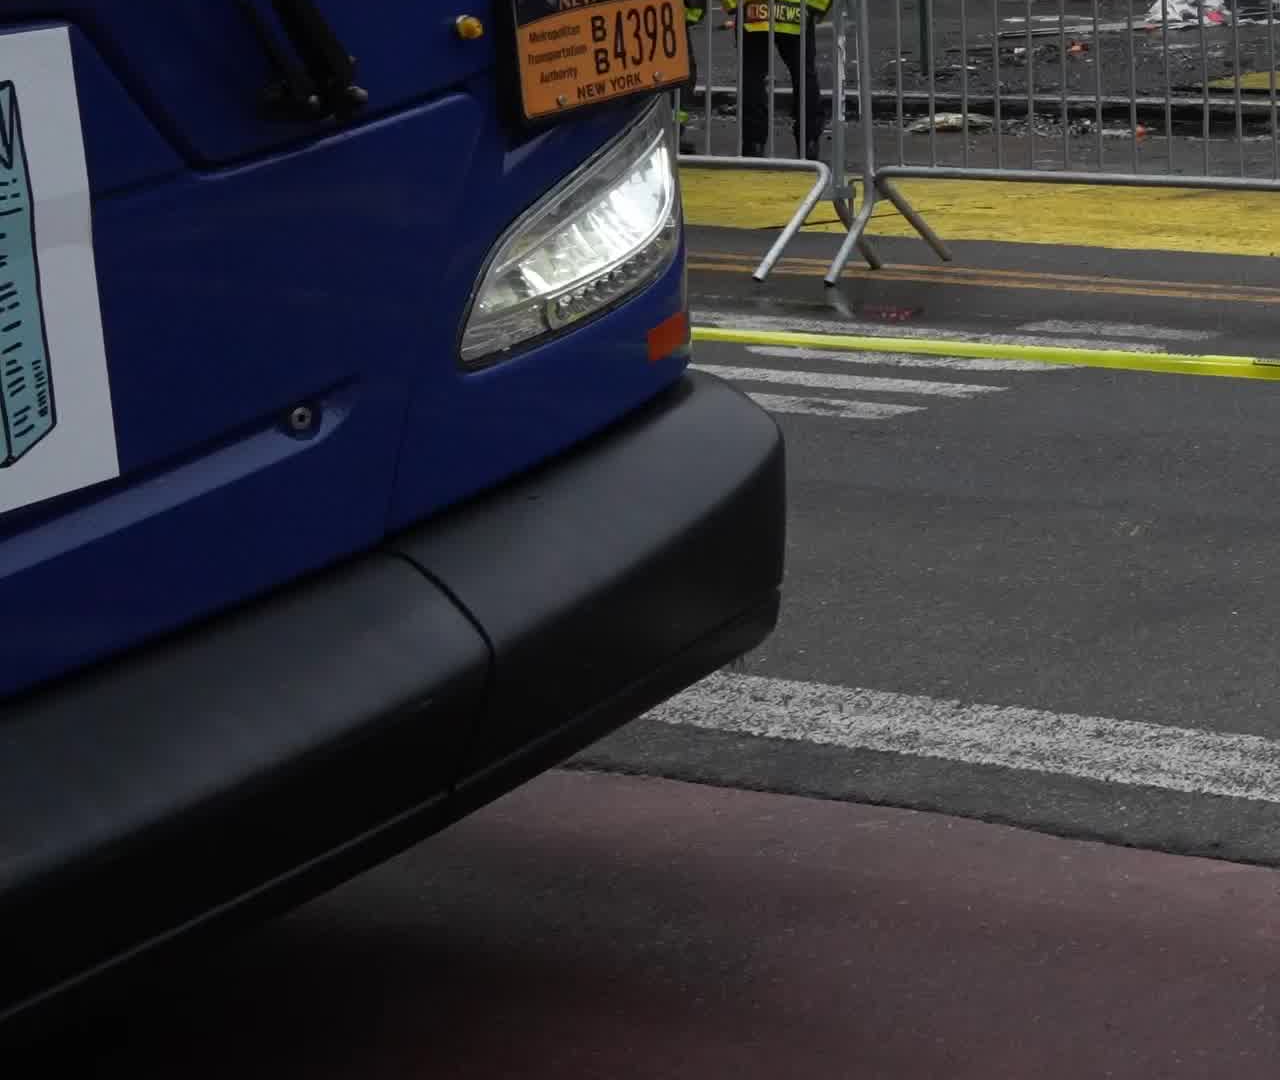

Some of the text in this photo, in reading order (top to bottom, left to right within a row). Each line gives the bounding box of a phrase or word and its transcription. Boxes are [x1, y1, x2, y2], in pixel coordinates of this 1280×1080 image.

[614, 1, 677, 70] 4398
[540, 66, 578, 84] Authority
[577, 72, 642, 100] NEW YORK
